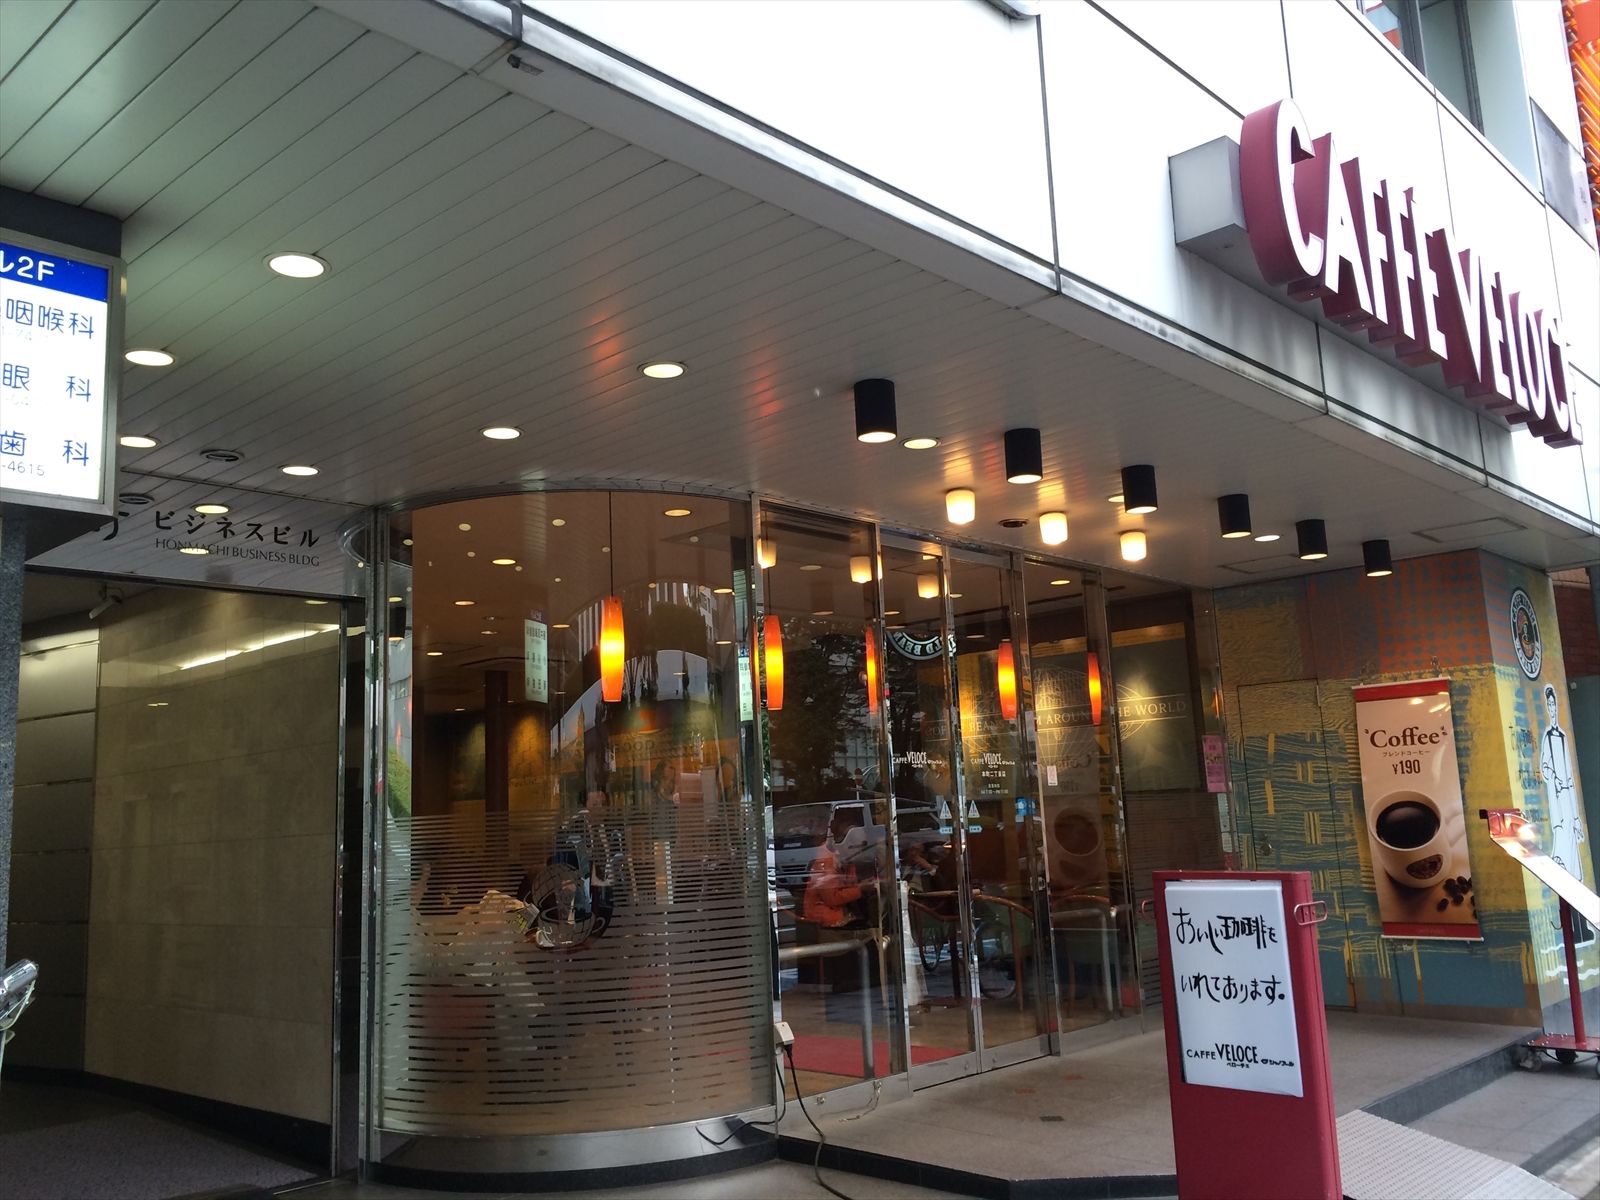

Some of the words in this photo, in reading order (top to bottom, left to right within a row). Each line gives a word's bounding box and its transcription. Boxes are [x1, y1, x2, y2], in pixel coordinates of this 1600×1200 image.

[1242, 98, 1448, 362] CAFFE
[155, 510, 320, 548] ビジネスビル
[155, 537, 230, 556] HONMACHI
[232, 546, 287, 564] BUSINESS
[289, 554, 320, 567] BLDG
[1046, 711, 1092, 725] AROUN
[1136, 701, 1187, 717] WORLD
[1369, 726, 1440, 748] Coffee
[906, 751, 927, 765] VELOCE
[1392, 759, 1421, 775] ¥190
[1186, 1049, 1216, 1060] CAFFE
[1215, 1043, 1259, 1064] VELOCE
